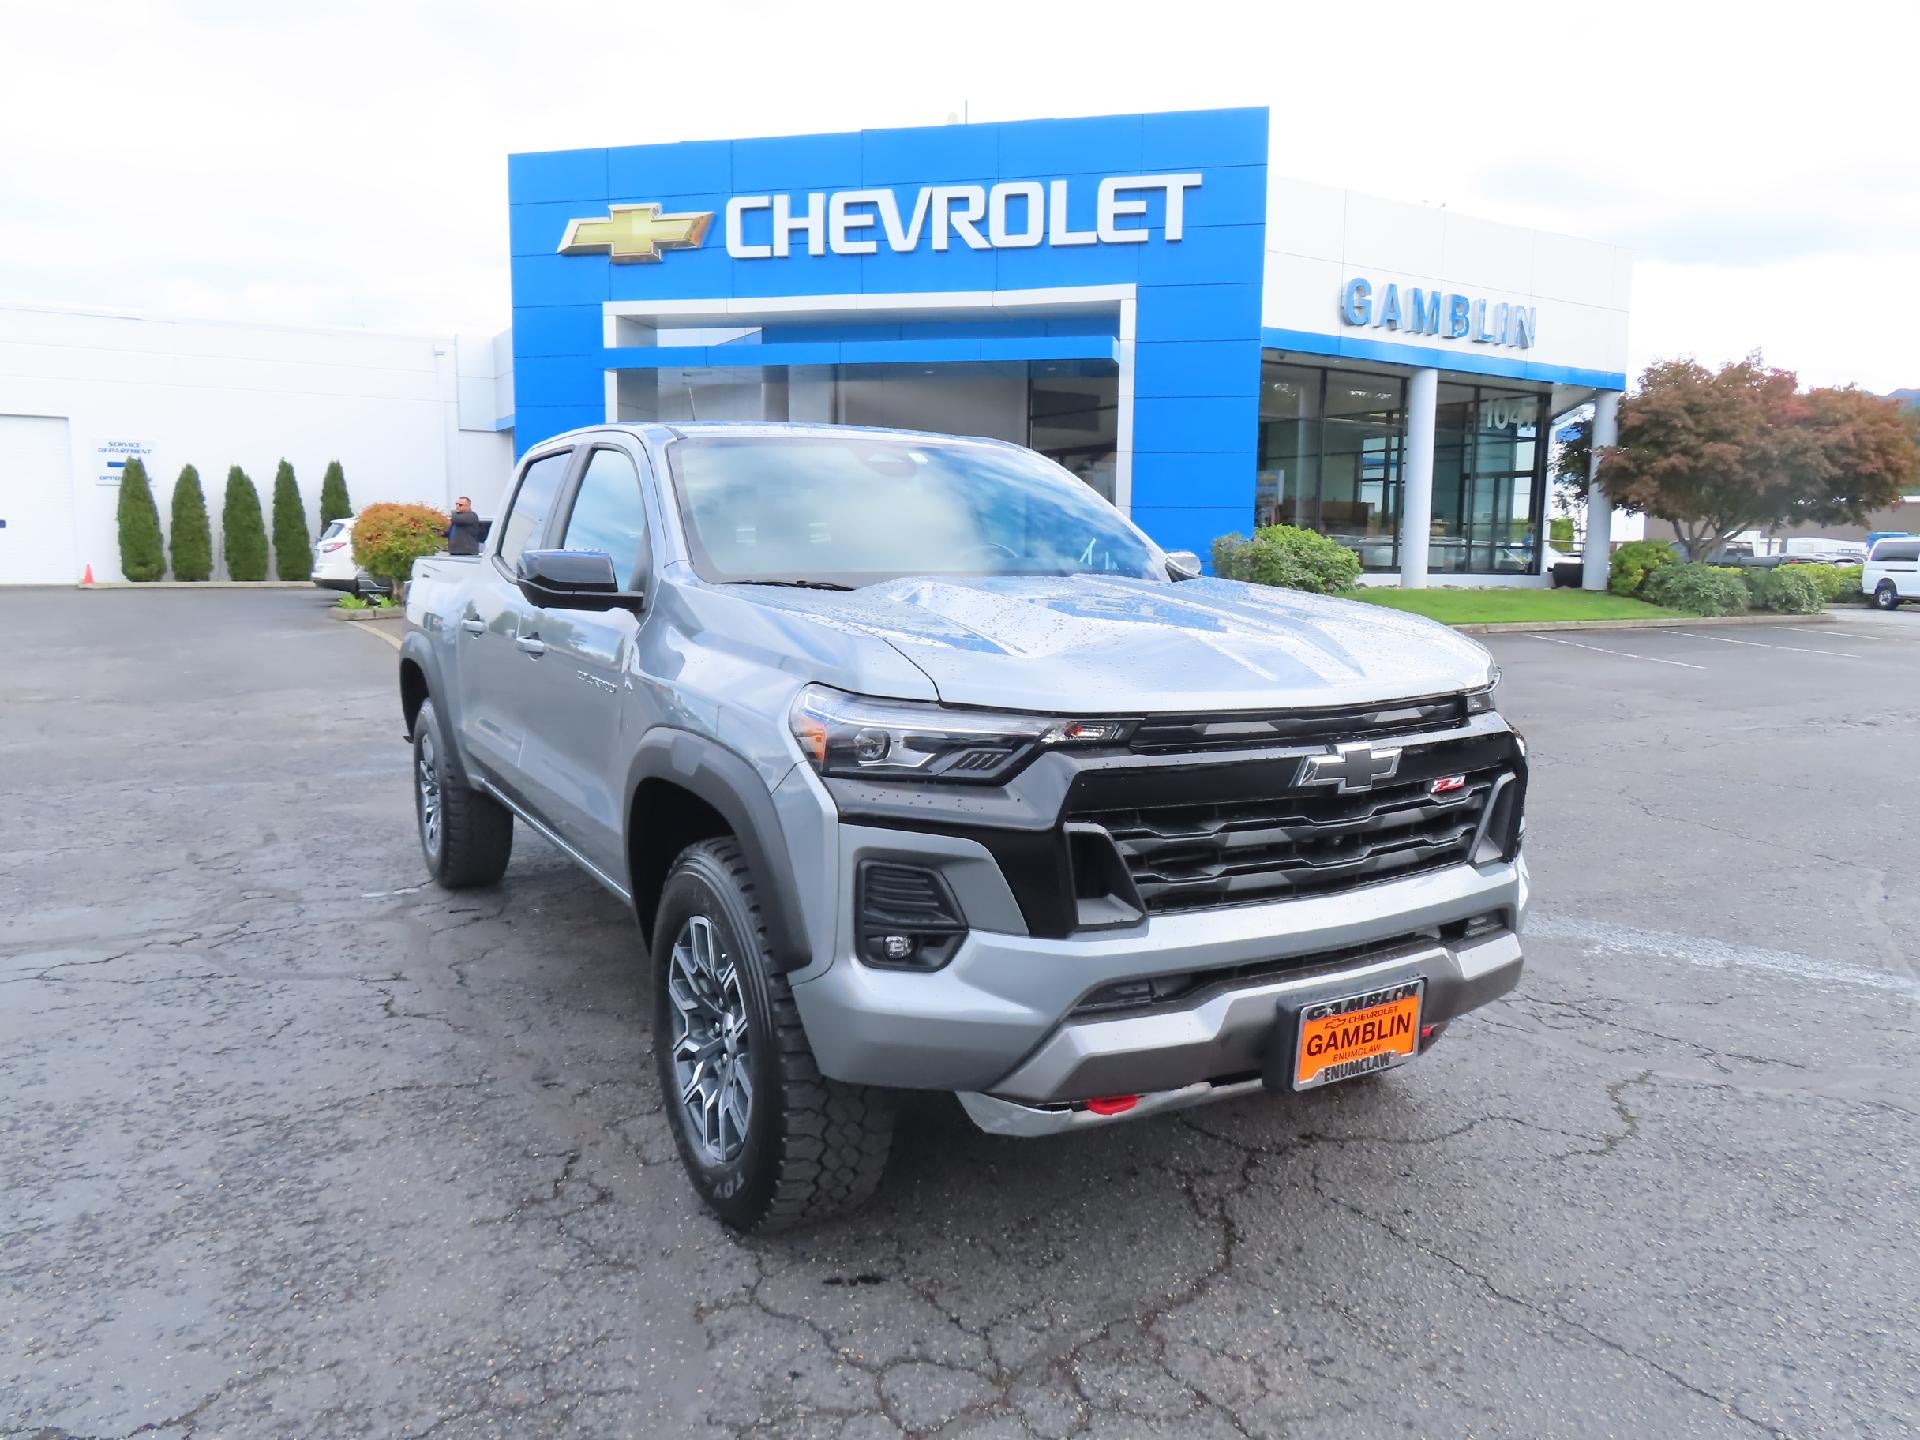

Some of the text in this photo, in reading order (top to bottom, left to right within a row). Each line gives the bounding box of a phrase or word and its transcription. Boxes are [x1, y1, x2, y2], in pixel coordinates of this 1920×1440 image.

[725, 173, 1202, 259] CHEVROLET
[1342, 277, 1537, 350] GAMBLIN
[1347, 1005, 1399, 1024] CHEVROLET
[1306, 1012, 1412, 1057] GAMBLIN
[1332, 1043, 1383, 1063] ENUMCLAW
[1324, 1051, 1392, 1082] ENUMCLAW
